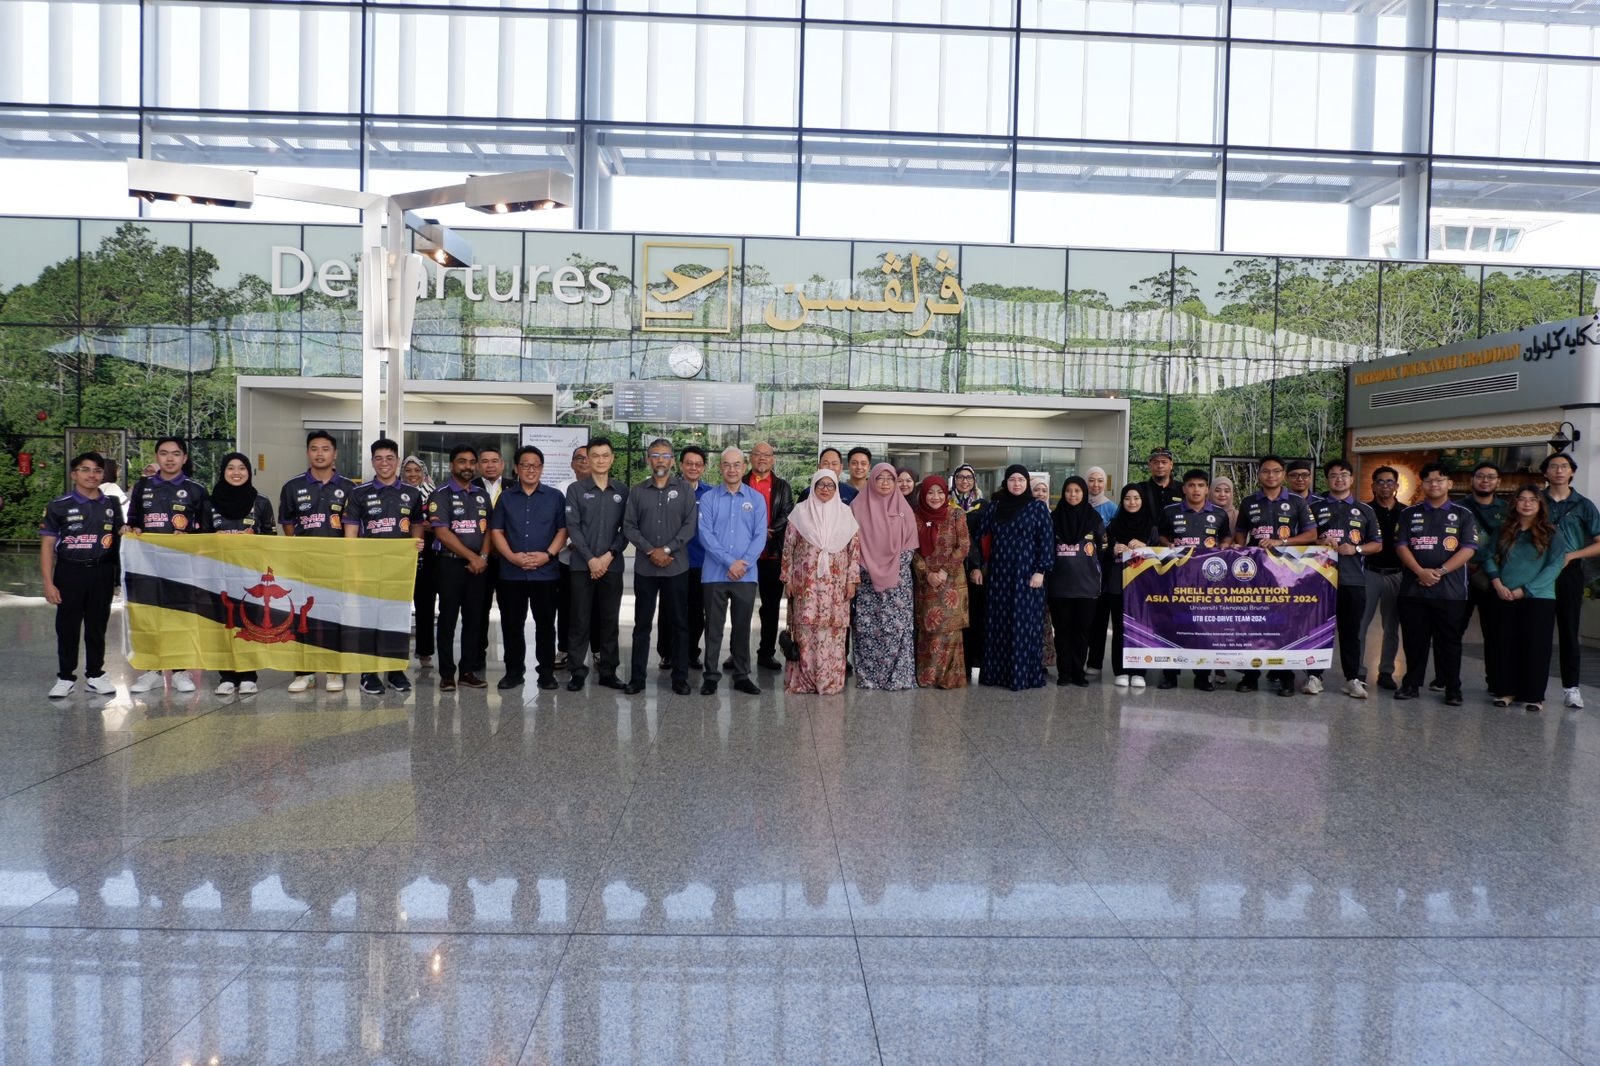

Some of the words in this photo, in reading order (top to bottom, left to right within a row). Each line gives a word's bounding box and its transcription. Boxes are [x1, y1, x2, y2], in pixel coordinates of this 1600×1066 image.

[272, 246, 613, 311] Dertures
[1174, 587, 1204, 595] SHELL
[1207, 587, 1228, 595] ECO
[1230, 587, 1289, 595] MARATHON
[1145, 595, 1169, 603] ASIA
[1172, 595, 1212, 603] PACIFIC
[1224, 595, 1262, 603] MIDDLE
[1265, 595, 1291, 603] EAST
[1293, 595, 1318, 603] 2024
